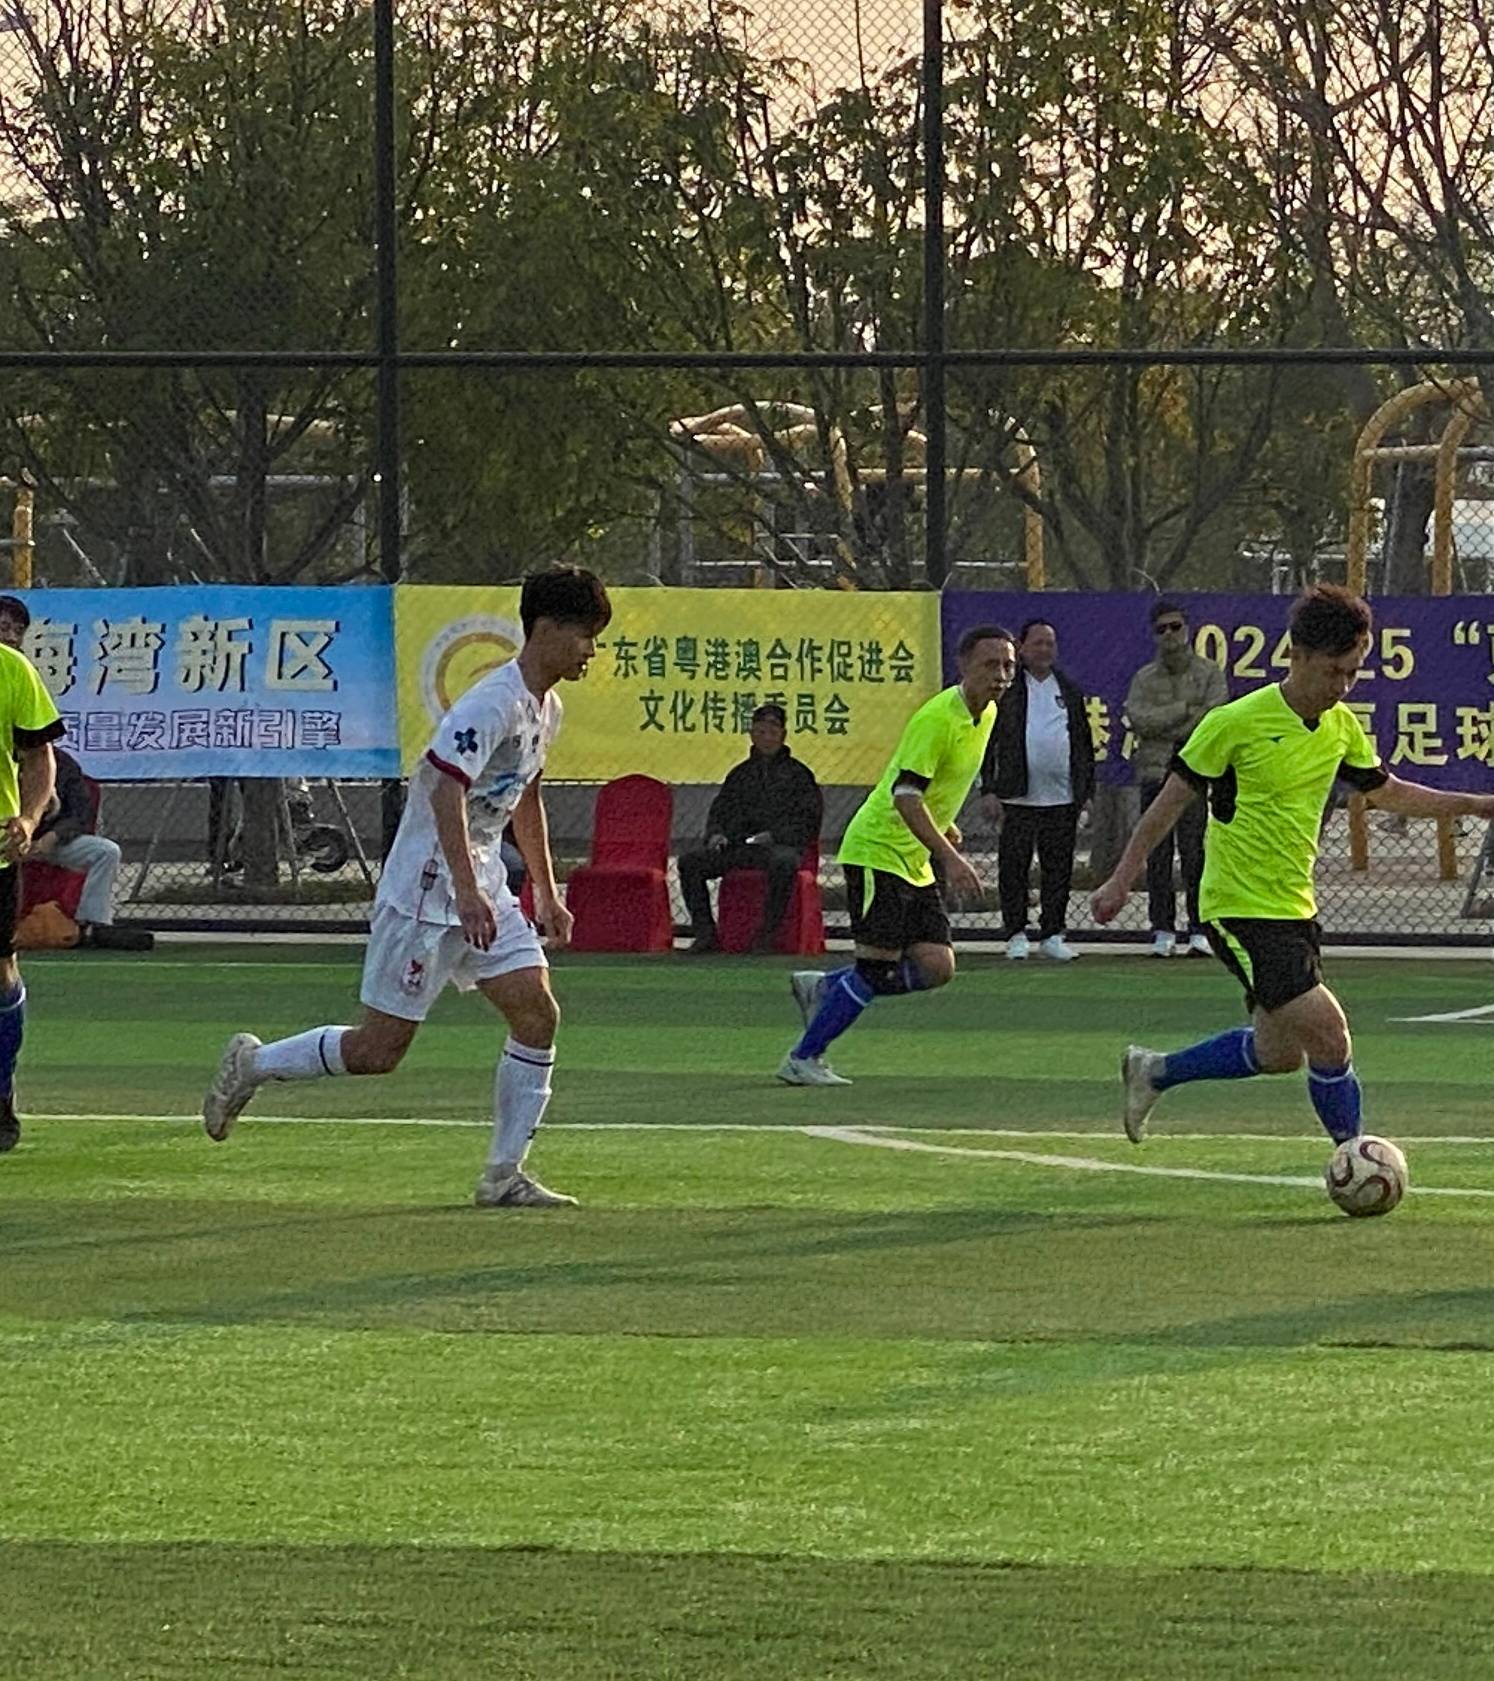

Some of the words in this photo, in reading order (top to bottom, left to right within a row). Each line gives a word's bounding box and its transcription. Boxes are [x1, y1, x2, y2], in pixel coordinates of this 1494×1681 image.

[22, 615, 340, 695] 海湾新区
[595, 635, 915, 684] 东省粤港澳合作促进会
